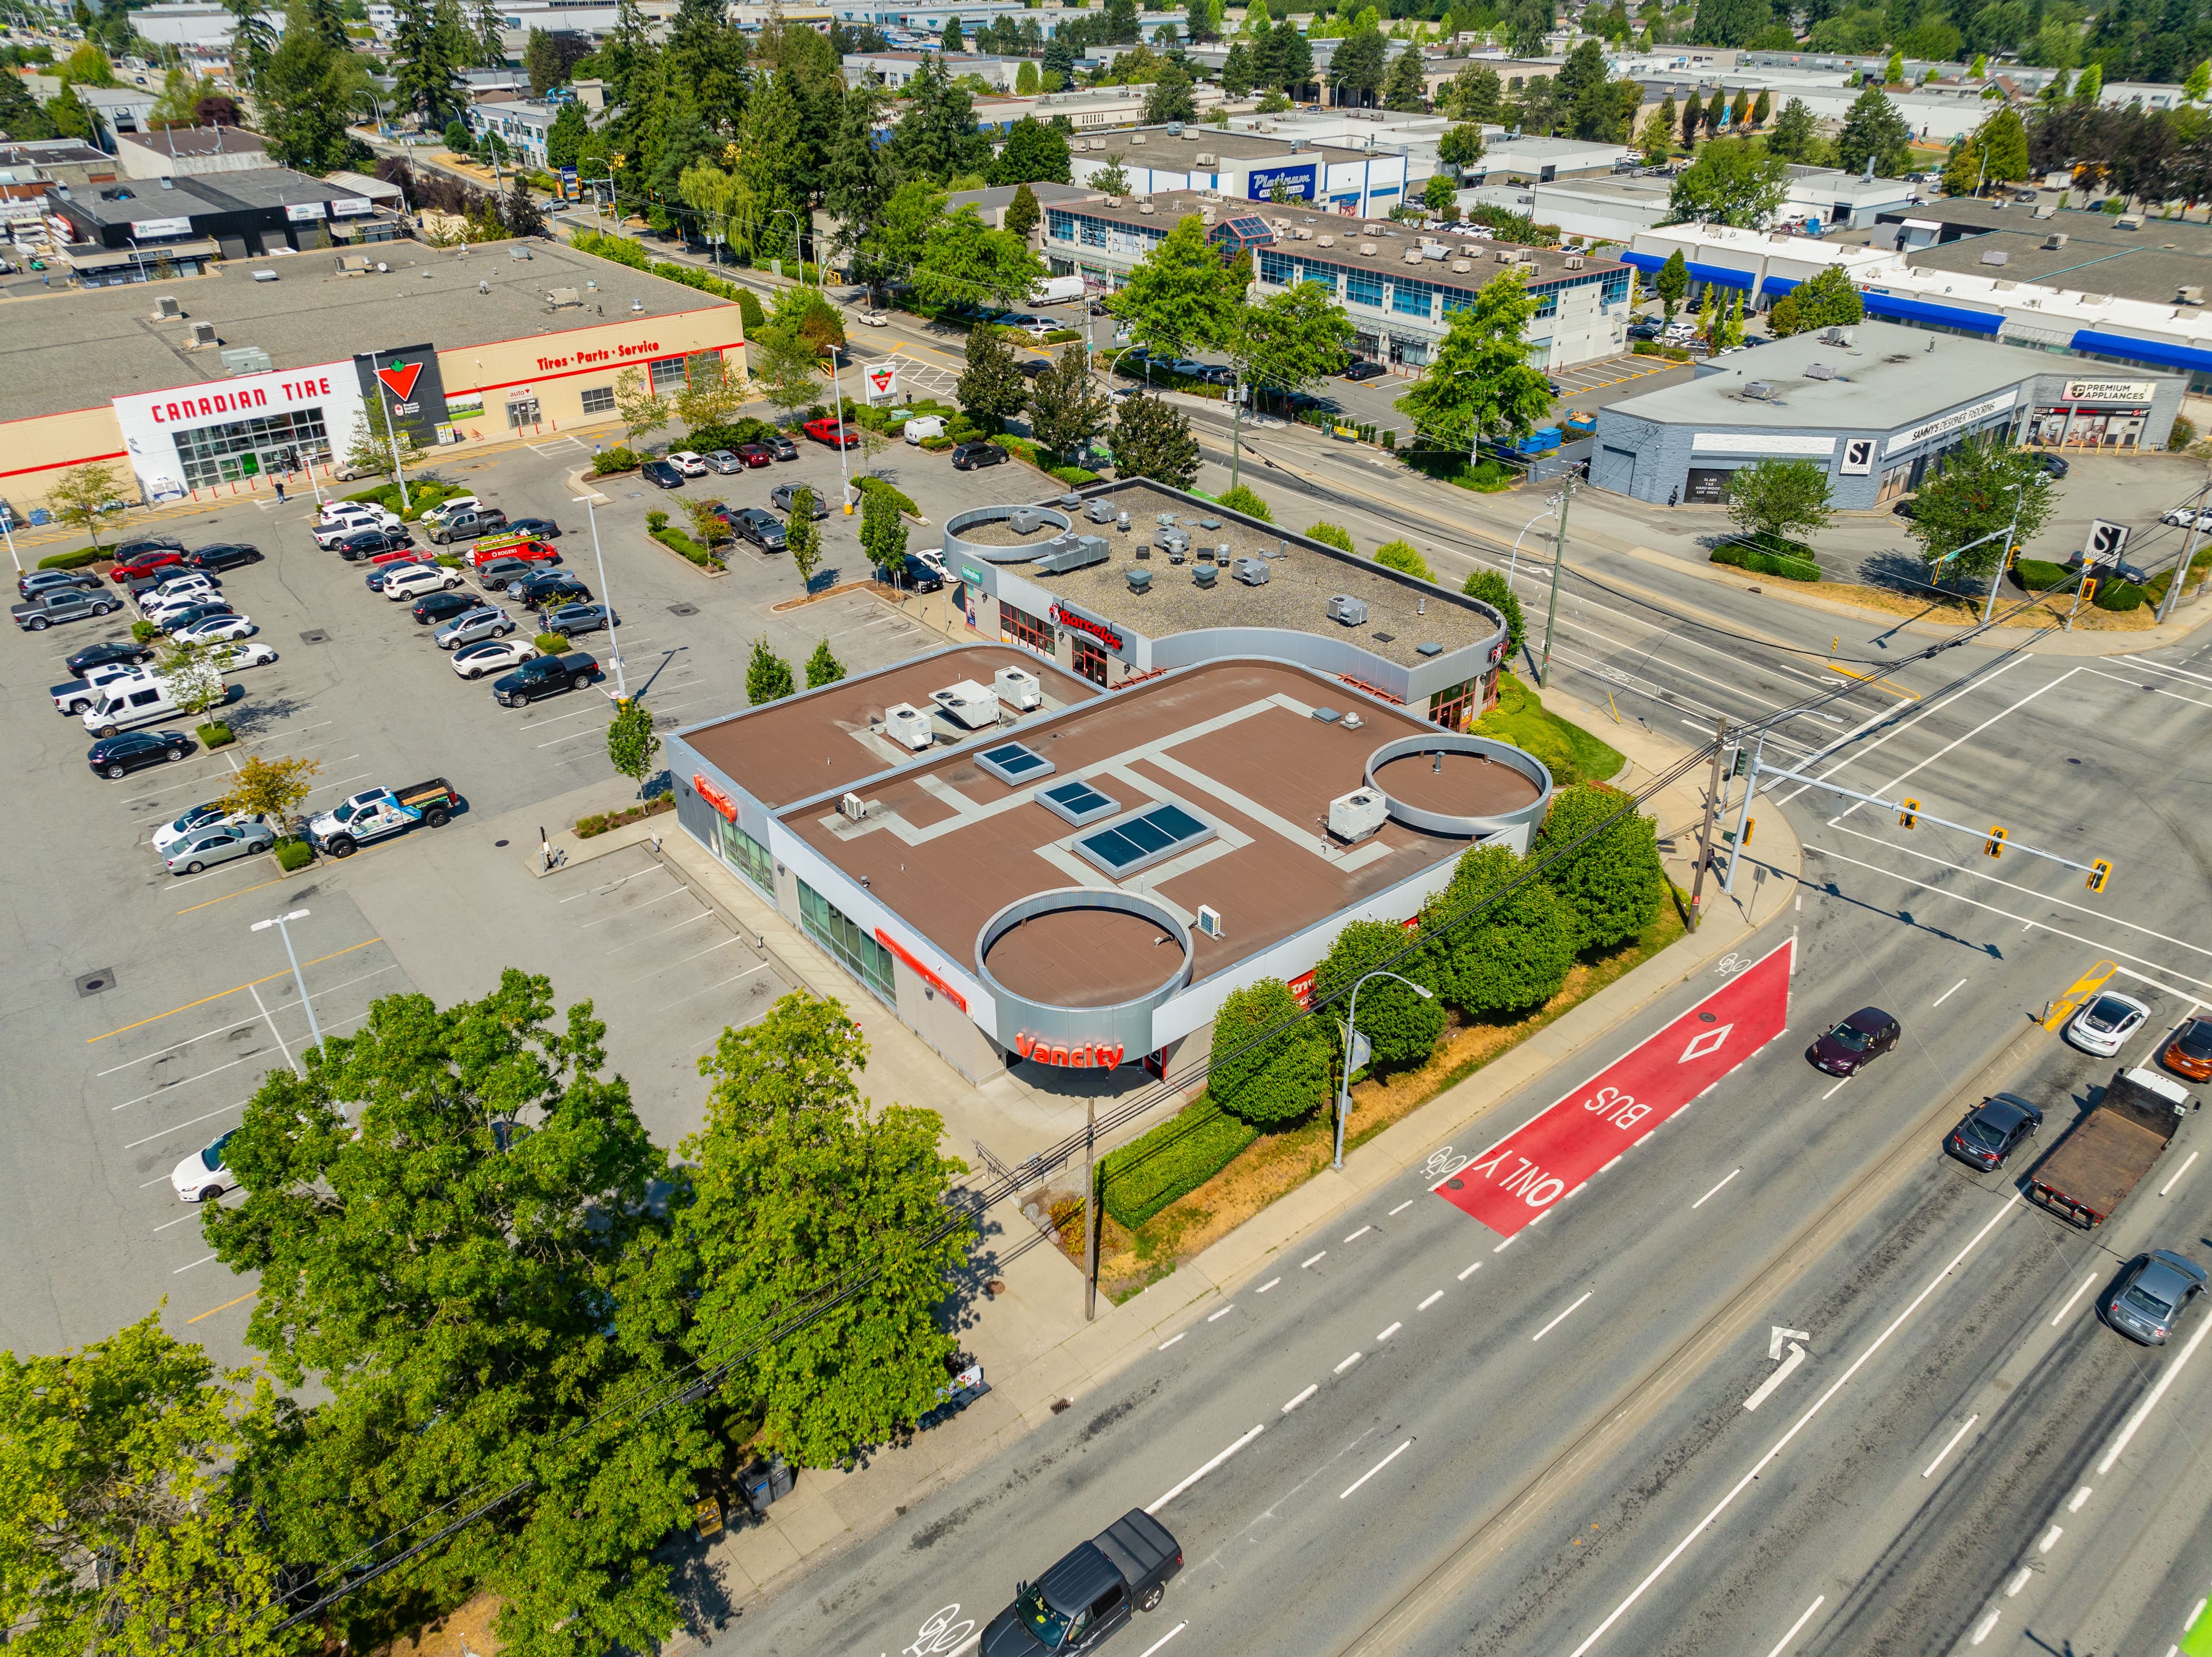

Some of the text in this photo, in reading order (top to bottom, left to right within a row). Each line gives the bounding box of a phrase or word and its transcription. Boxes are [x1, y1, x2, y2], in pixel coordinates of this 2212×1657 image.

[1253, 172, 1310, 189] Platinum
[537, 341, 660, 371] Tires Parts Service
[151, 377, 331, 423] CANADIAN TIRE
[2084, 392, 2145, 400] APPLIANCES
[1912, 402, 1995, 441] SAMMY'S DESIGNER FLOORING
[497, 548, 518, 556] ROGERS
[1059, 610, 1123, 650] Barcelos
[692, 774, 737, 824] Vancity
[1015, 1031, 1124, 1072] Vancity
[1584, 1087, 1653, 1131] BUS
[1472, 1149, 1565, 1208] ONLY
